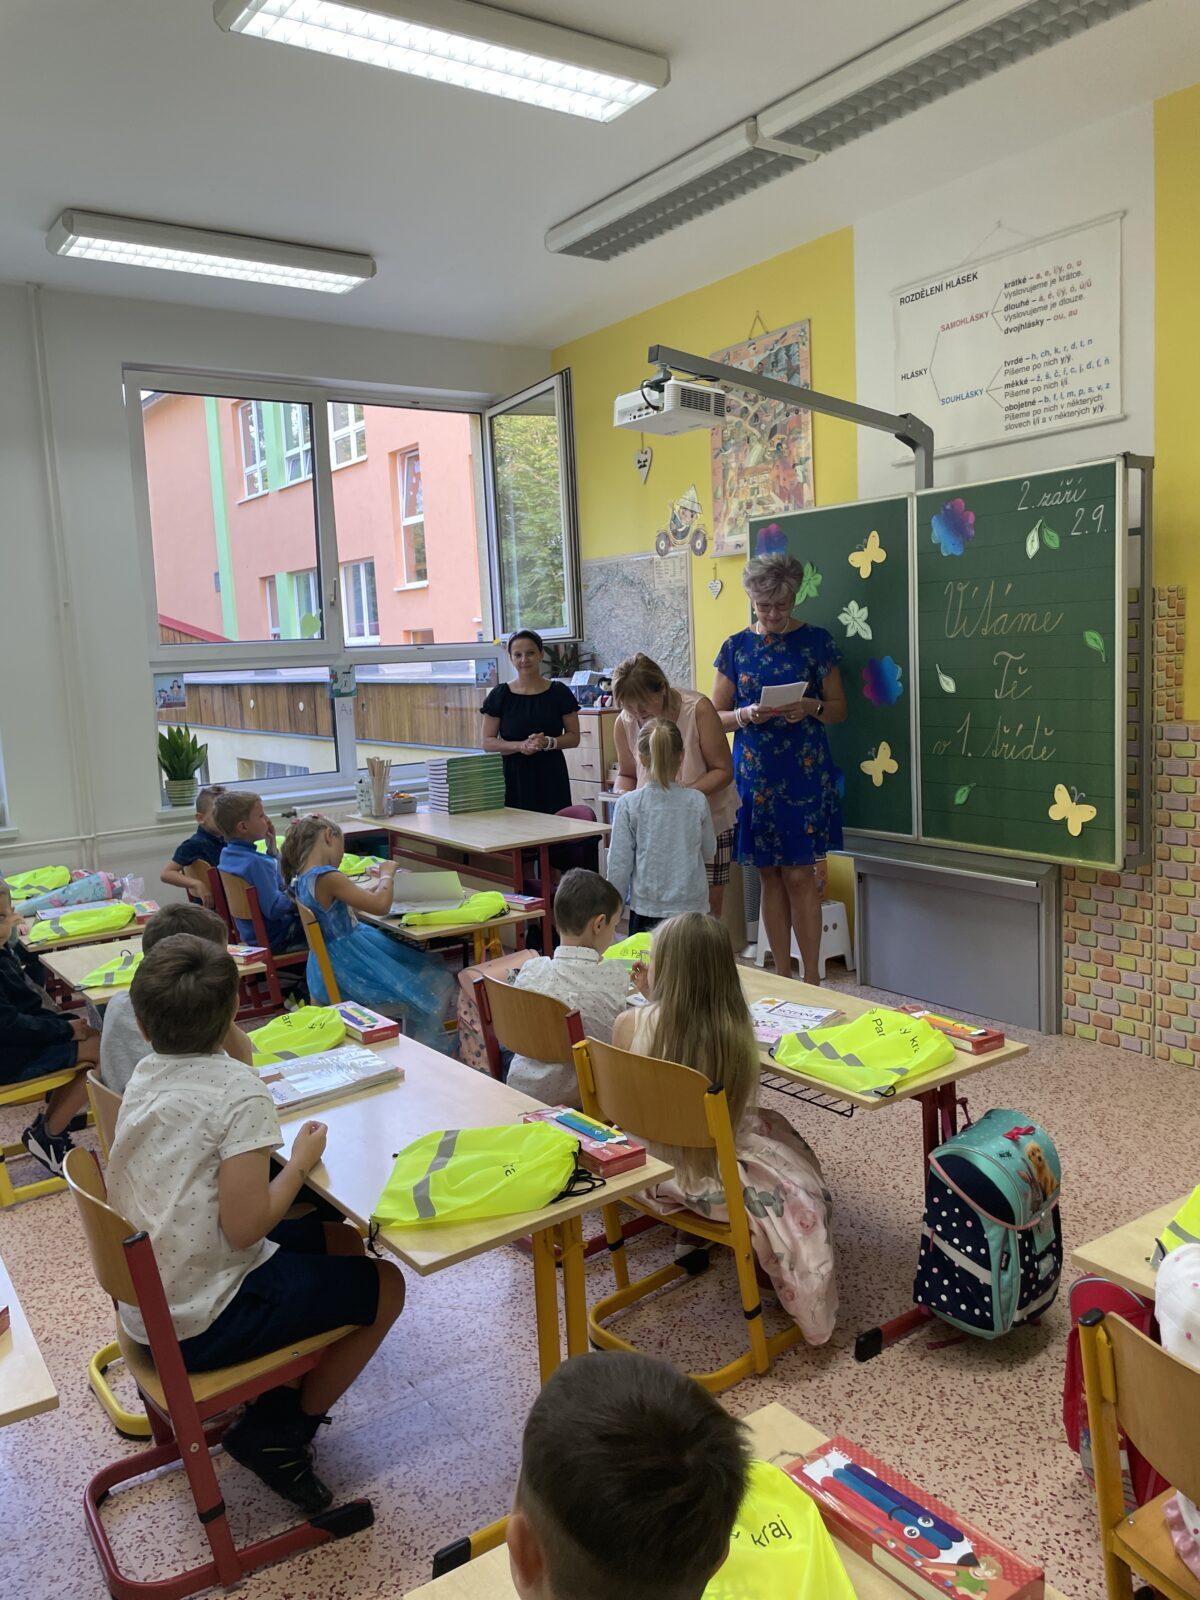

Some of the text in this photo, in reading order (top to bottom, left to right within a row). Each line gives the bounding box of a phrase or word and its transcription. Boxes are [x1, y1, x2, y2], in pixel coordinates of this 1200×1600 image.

[900, 272, 978, 306] ROZDĚLENÍ HLÁSEK
[1004, 281, 1048, 299] Vyslovujeme
[1050, 278, 1056, 287] je
[1004, 299, 1029, 312] dlouhé
[1004, 304, 1048, 322] Vyslovujeme
[1050, 302, 1056, 310] je
[940, 310, 989, 332] SAMOHLÁSKY
[1004, 318, 1044, 334] dvojhlásky
[1032, 363, 1042, 371] po
[1044, 358, 1058, 368] nich
[941, 388, 984, 405] SOUHLÁSKY
[1032, 386, 1042, 394] po
[1044, 381, 1058, 390] nich
[1004, 400, 1036, 412] obojetné
[1032, 408, 1042, 416] po
[1044, 404, 1058, 414] nich
[1004, 420, 1030, 431] slovech
[944, 580, 1064, 638] Vítáme
[993, 651, 1032, 700] Tě
[932, 711, 1056, 760] v 1. třídě
[750, 1514, 792, 1549] kraj
